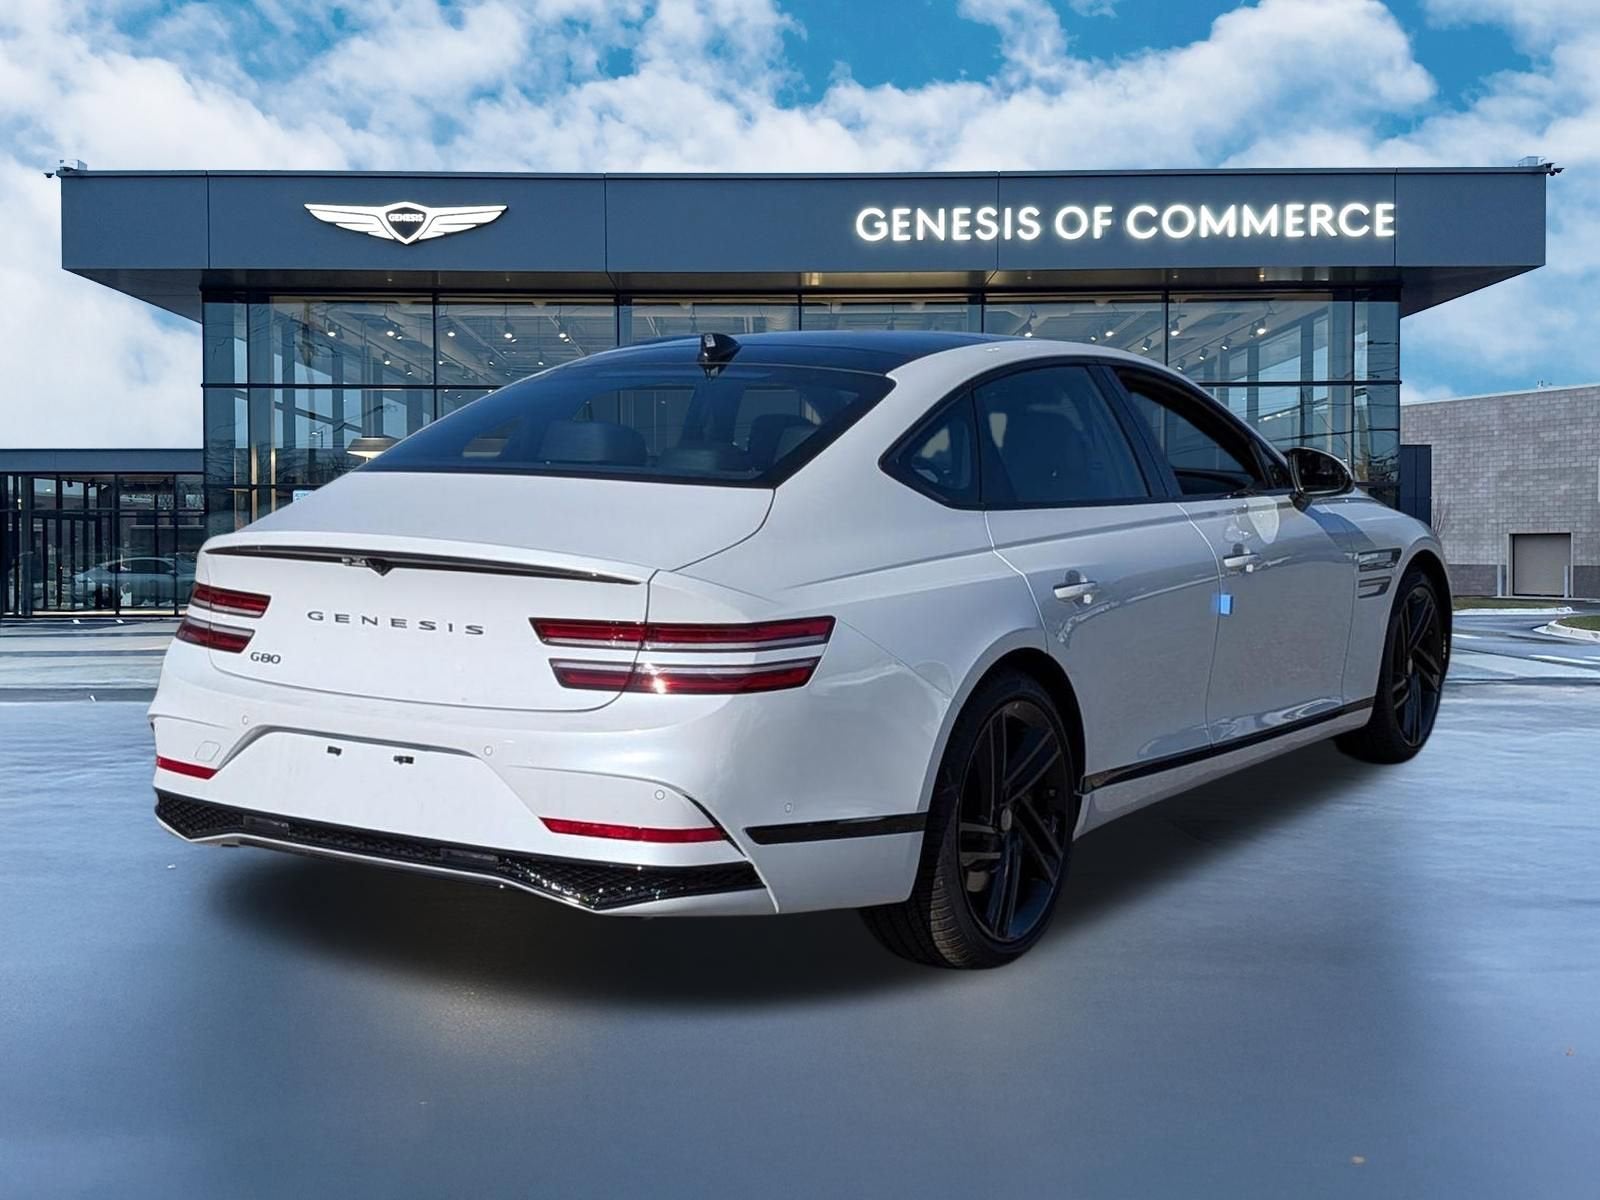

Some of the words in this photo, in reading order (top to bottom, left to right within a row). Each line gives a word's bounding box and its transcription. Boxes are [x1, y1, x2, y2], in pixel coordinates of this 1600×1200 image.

[388, 213, 424, 222] GENESIS
[855, 206, 1041, 243] GENESIS
[1054, 204, 1113, 241] OF
[1126, 202, 1396, 240] COMMERCE
[307, 611, 484, 635] GENESIS
[250, 651, 281, 665] G80
